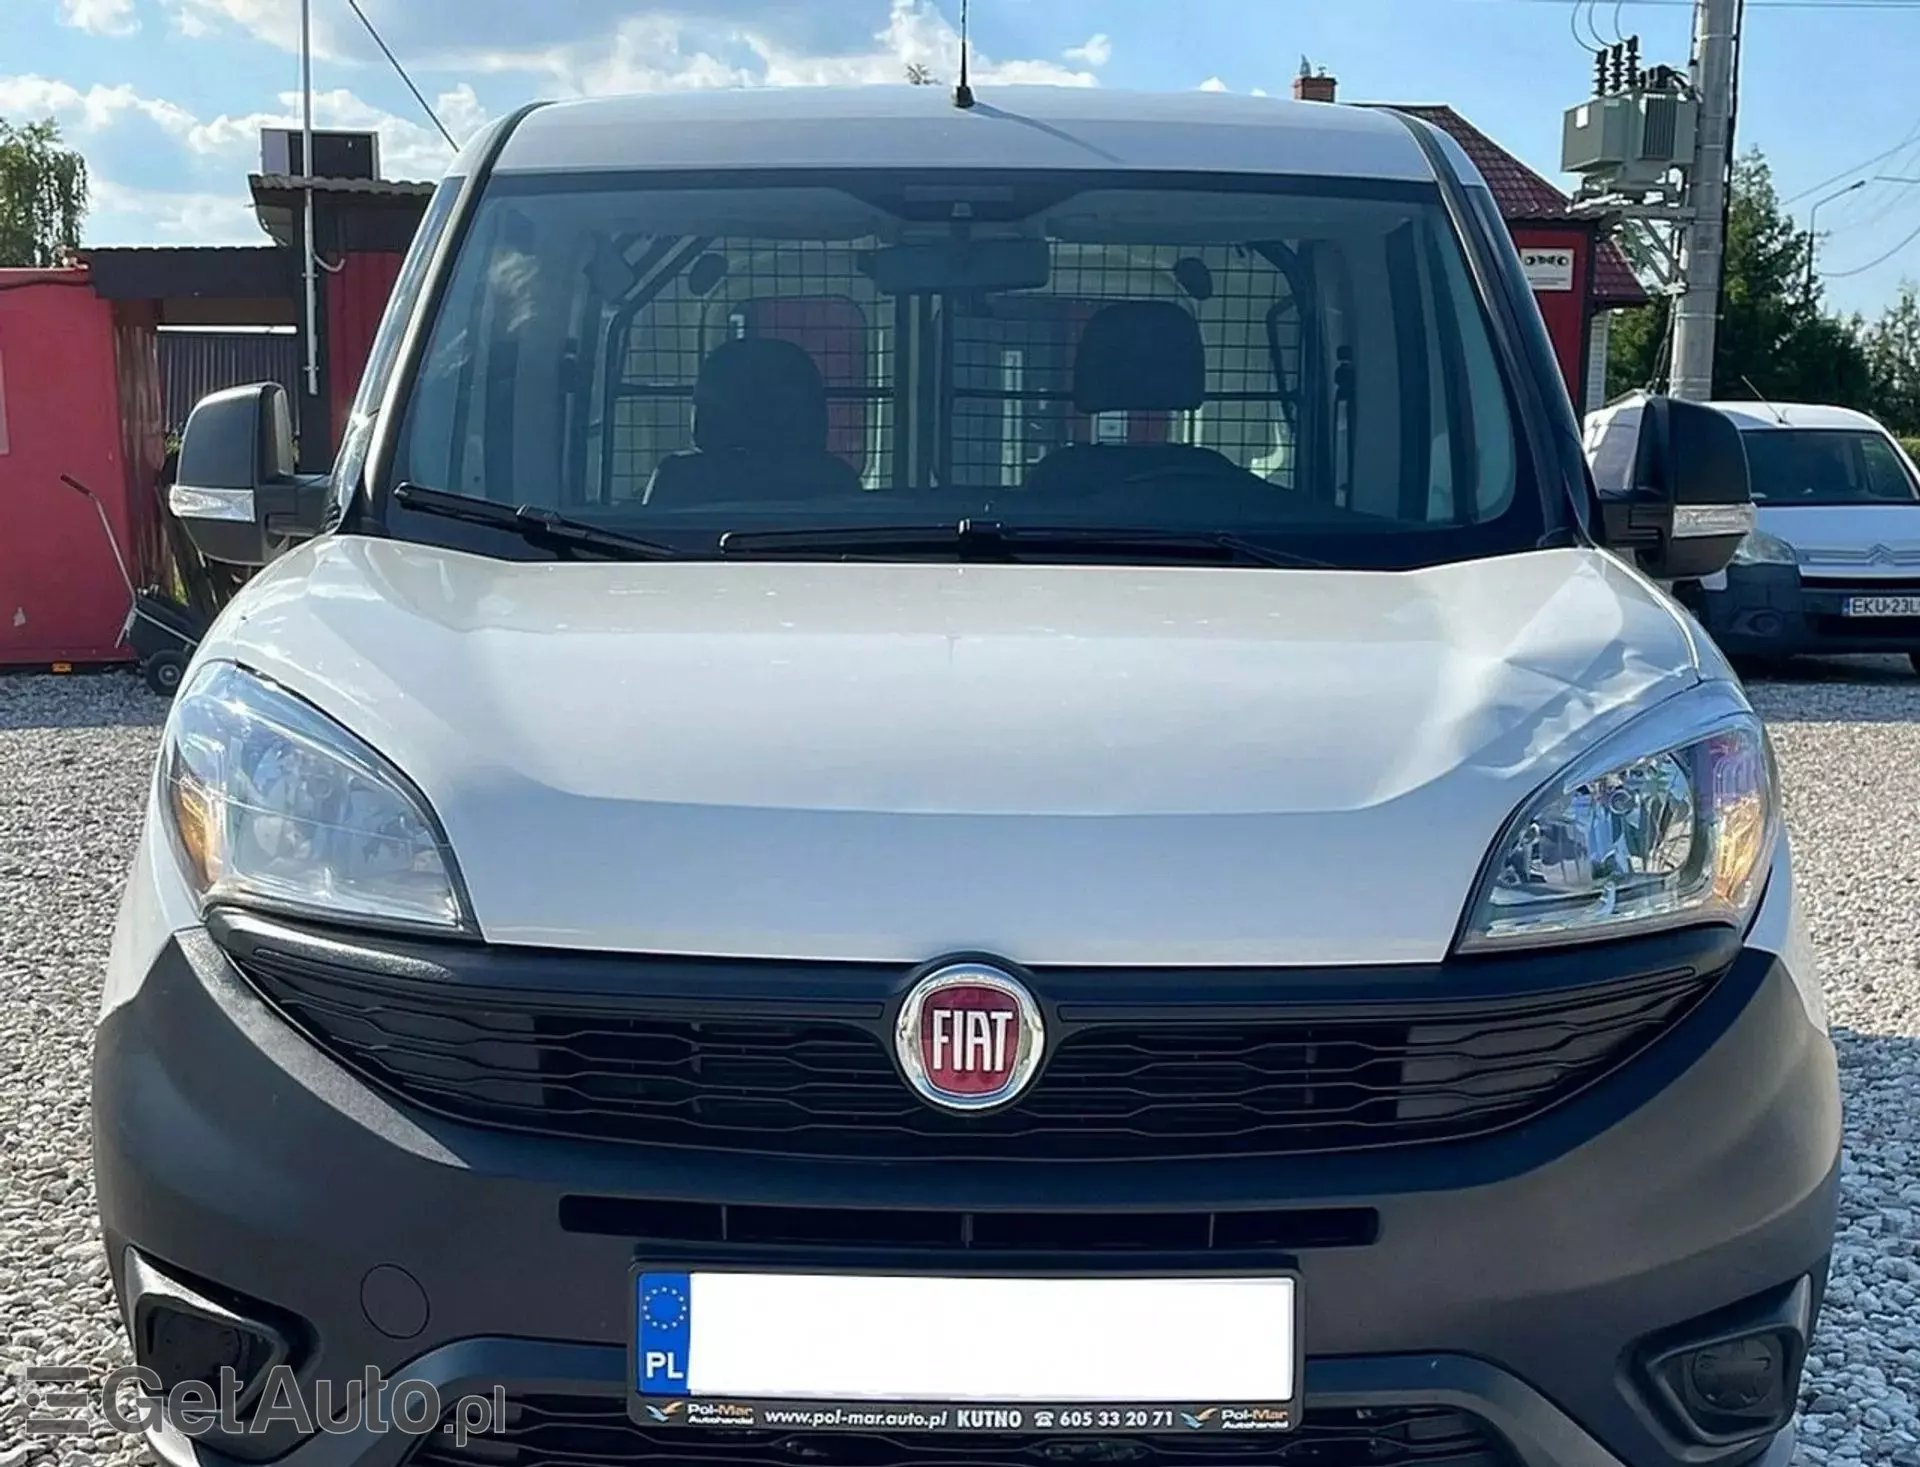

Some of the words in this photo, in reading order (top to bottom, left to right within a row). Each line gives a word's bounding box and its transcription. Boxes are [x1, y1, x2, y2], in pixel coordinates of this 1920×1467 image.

[933, 1009, 1014, 1072] FIAT
[646, 1352, 684, 1379] PL
[687, 1404, 753, 1416] Pol-Mar
[765, 1408, 948, 1429] www.pol-mar.auto.pl
[956, 1410, 1022, 1428] KUTNO
[1060, 1411, 1092, 1427] 605
[1098, 1411, 1120, 1427] 33
[1125, 1411, 1148, 1427] 20
[1152, 1411, 1173, 1427] 71
[1221, 1408, 1289, 1421] Pol-Mar
